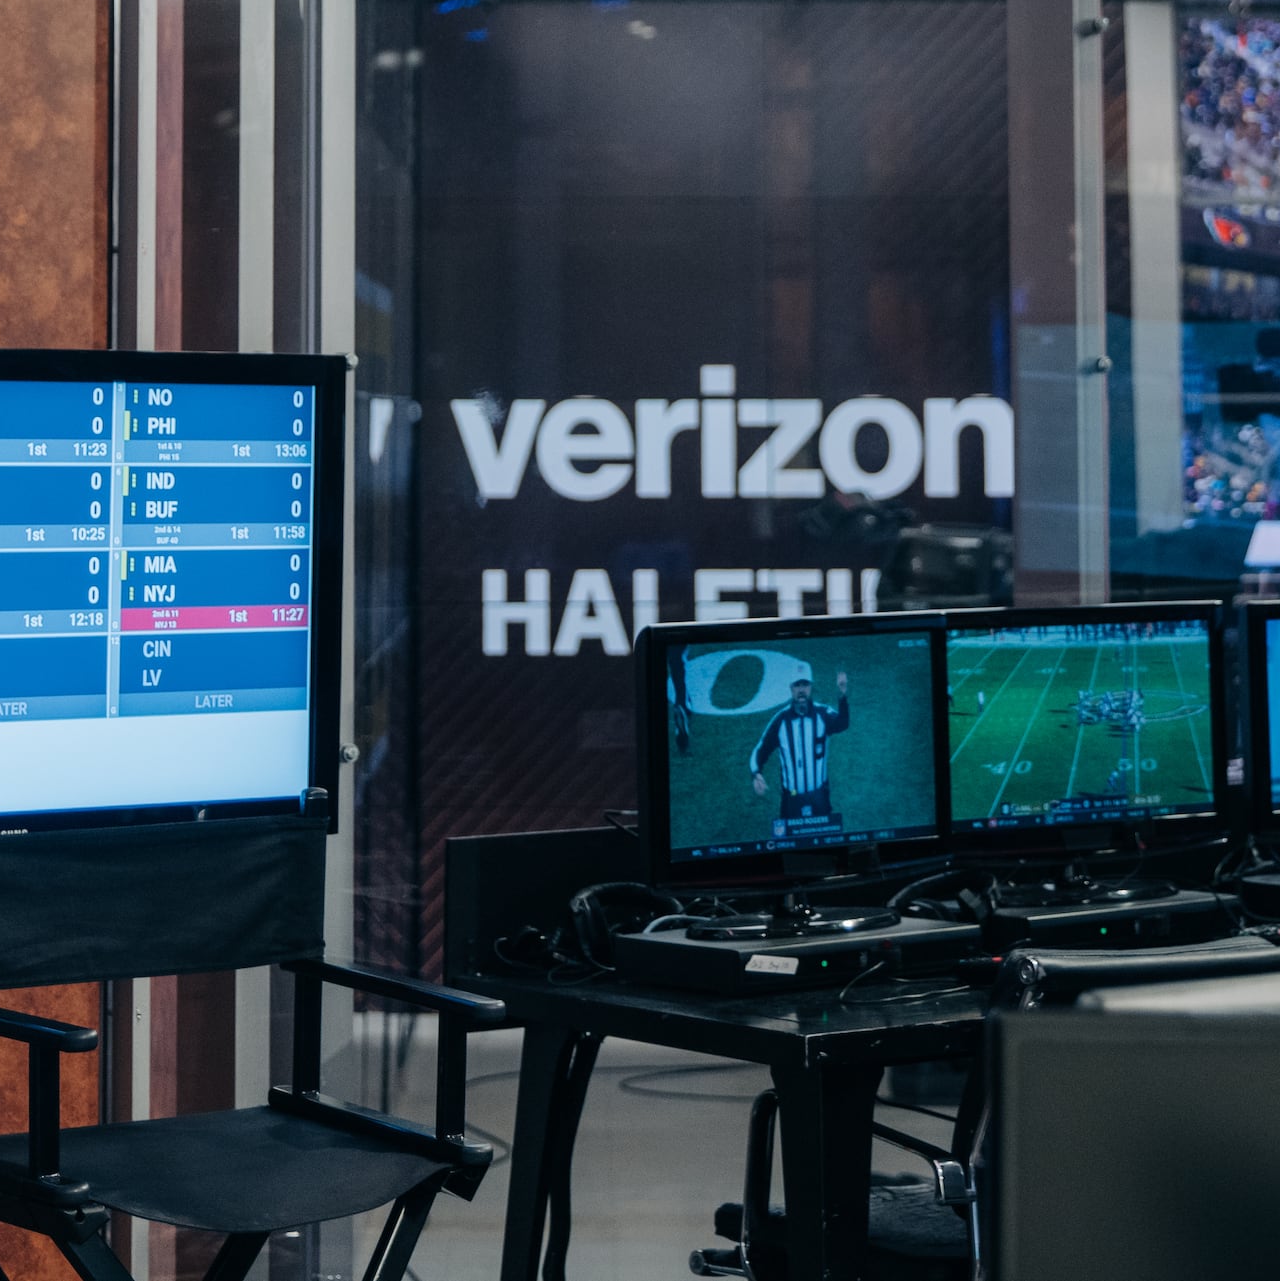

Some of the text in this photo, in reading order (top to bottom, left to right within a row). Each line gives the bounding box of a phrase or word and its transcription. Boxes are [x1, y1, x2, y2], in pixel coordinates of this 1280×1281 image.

[93, 388, 103, 405] 0
[148, 389, 303, 408] NO 0
[92, 417, 103, 434] 0
[147, 418, 303, 436] PHI 0
[450, 364, 1015, 500] verizon
[28, 443, 107, 456] 1st 11:23
[232, 444, 307, 457] 1st 13:06
[91, 472, 101, 489] 0
[147, 472, 302, 489] IND 0
[90, 501, 101, 518] 0
[146, 501, 301, 518] BUF 0
[25, 528, 105, 541] 1st 10:25
[231, 526, 305, 539] 1st 11:58
[89, 557, 99, 574] 0
[144, 554, 300, 573] MIA 0
[88, 586, 99, 604] 0
[144, 583, 300, 602] NYJ 0
[24, 613, 103, 627] 1st 12:18
[229, 608, 304, 622] 1st 11:27
[482, 568, 881, 656] HAFTI
[143, 641, 171, 657] CIN
[143, 669, 161, 686] LV
[195, 695, 233, 708] LATER
